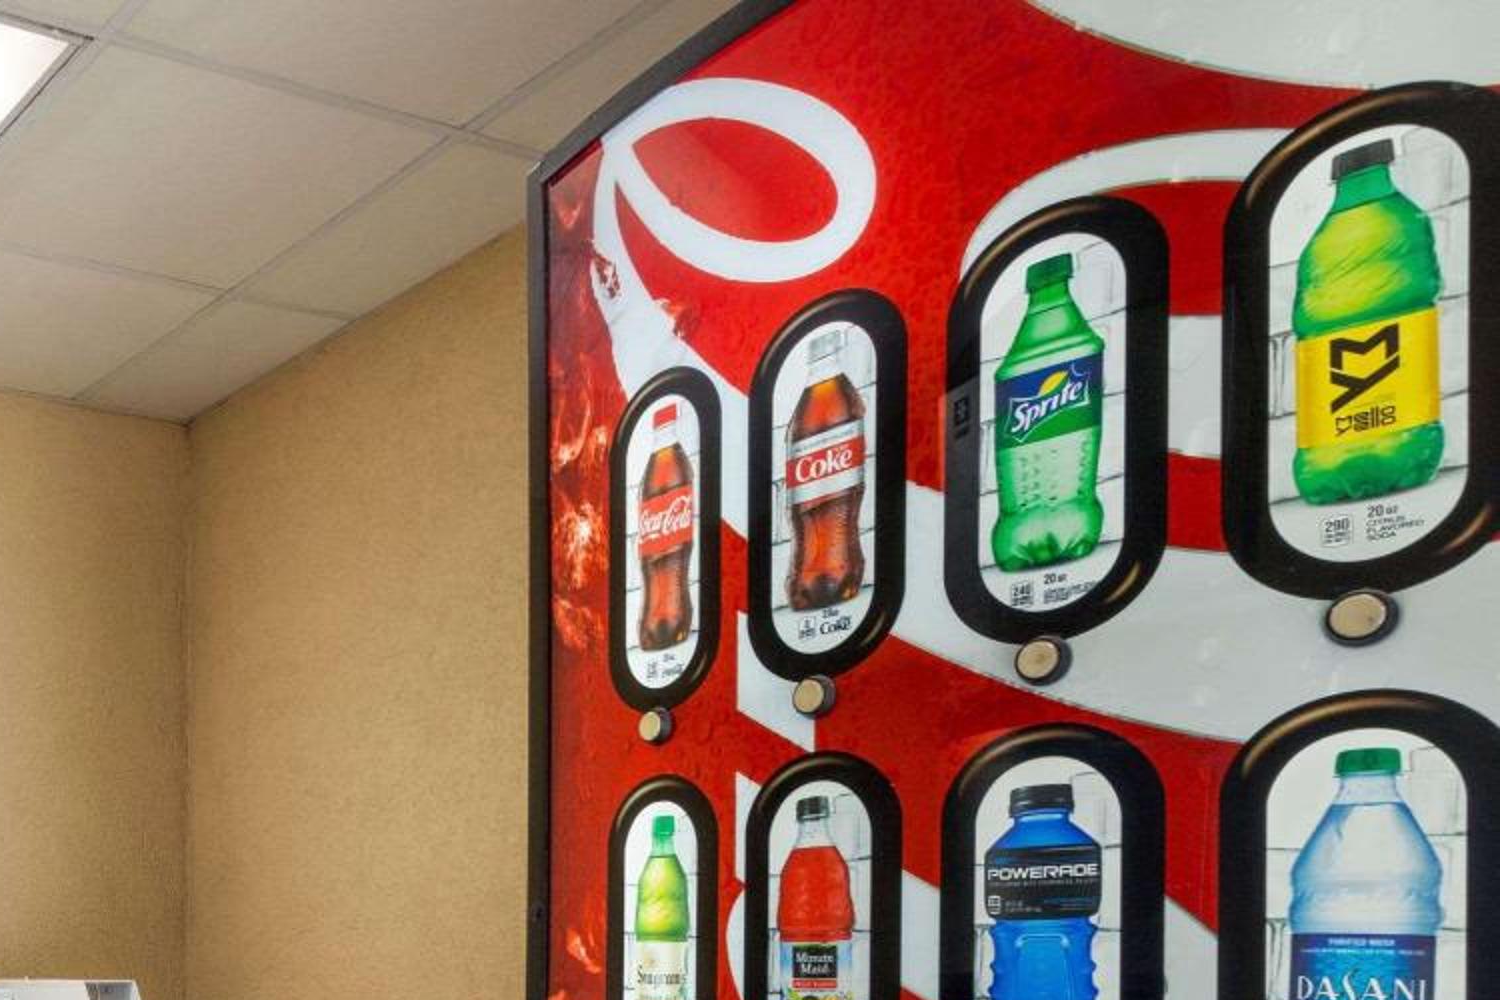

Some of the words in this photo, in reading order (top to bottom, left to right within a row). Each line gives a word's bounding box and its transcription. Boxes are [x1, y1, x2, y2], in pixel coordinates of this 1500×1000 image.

[1010, 380, 1083, 433] Sprite
[795, 446, 853, 483] Coke
[987, 863, 1099, 881] POWERADE
